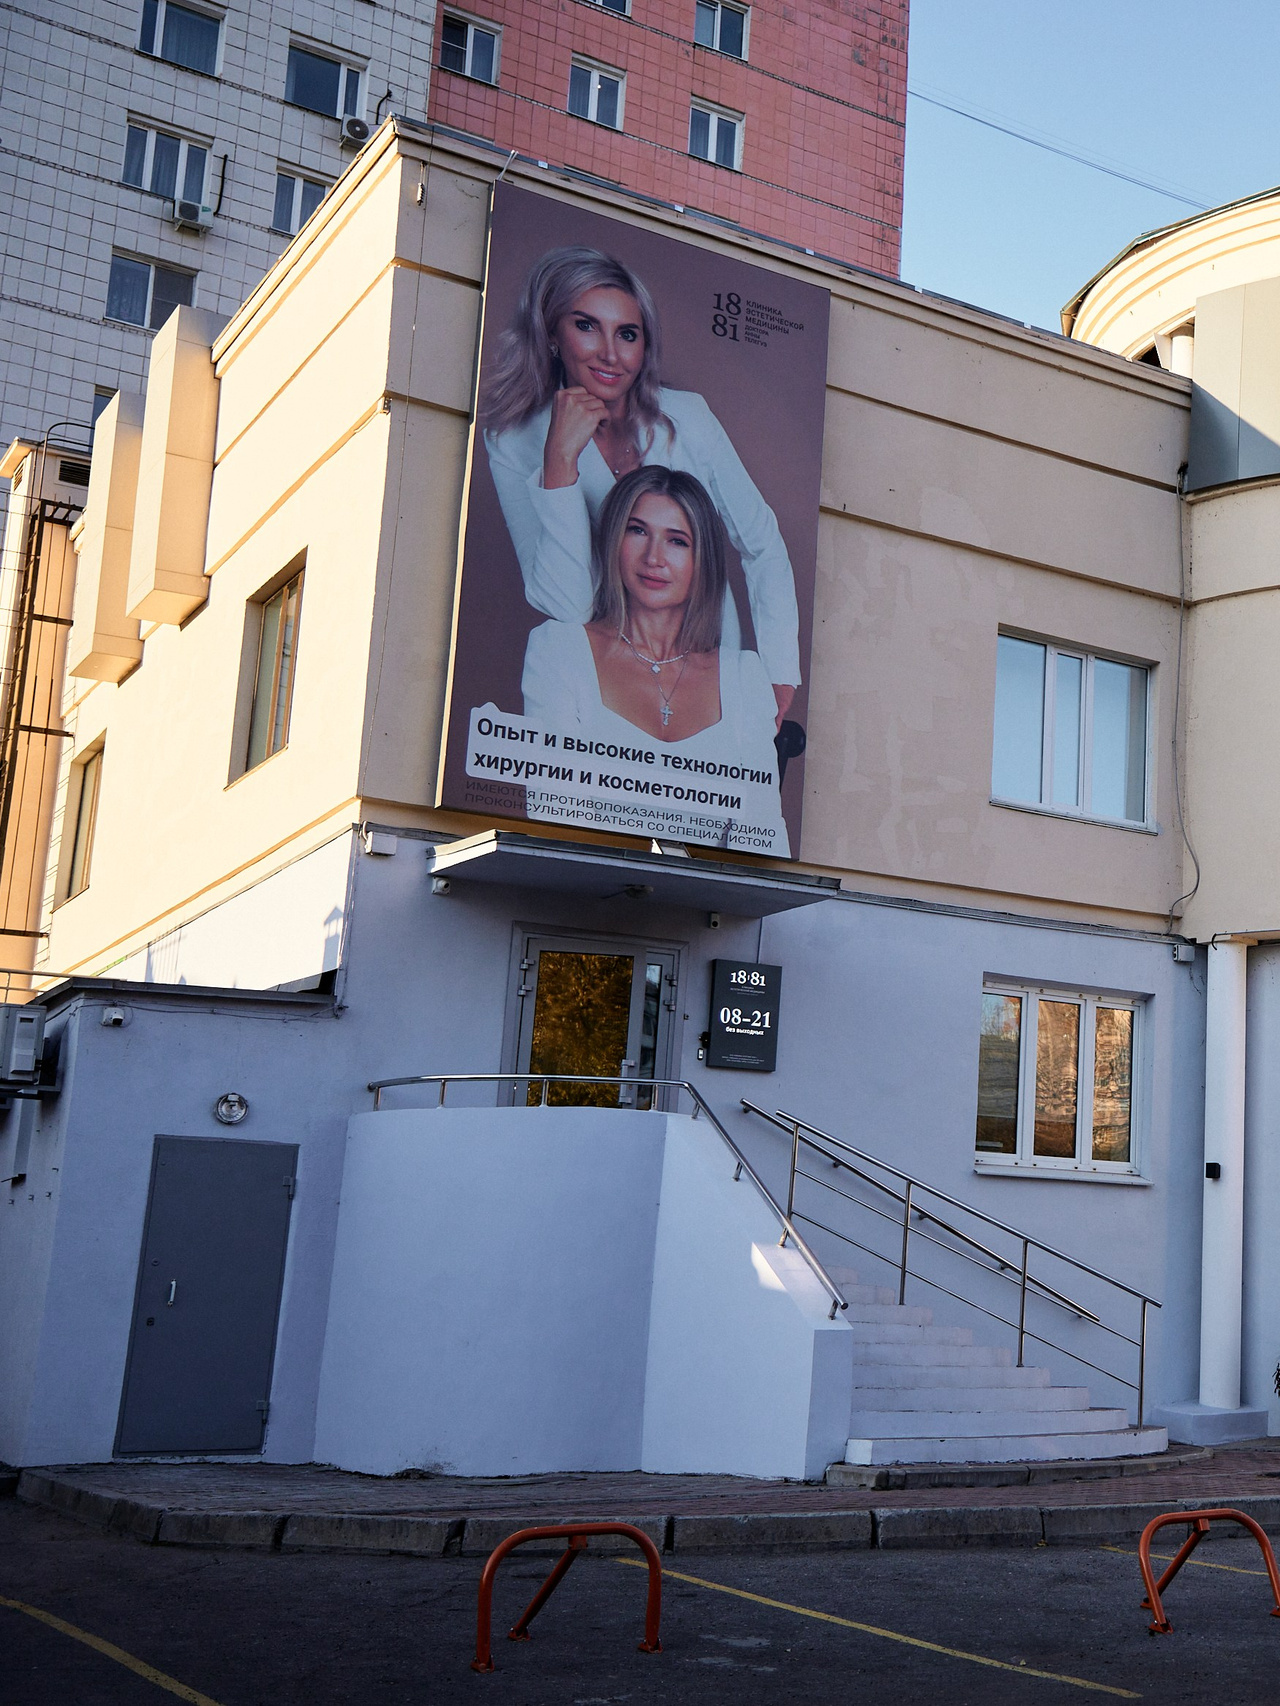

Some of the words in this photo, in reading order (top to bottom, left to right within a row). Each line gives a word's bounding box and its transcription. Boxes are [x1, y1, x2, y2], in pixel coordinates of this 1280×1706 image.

[713, 292, 742, 316] 18
[746, 300, 783, 317] КЛИНИКА
[712, 314, 740, 342] 81
[745, 308, 805, 331] ЭСТЕТИЧЕСКОЙ
[745, 316, 790, 335] МЕДИЦИНЫ
[477, 718, 539, 744] Опыт
[544, 733, 557, 748] и
[563, 736, 656, 765] высокие
[661, 753, 773, 785] технологии
[473, 752, 574, 781] хирургии
[579, 770, 592, 785] и
[598, 773, 742, 810] косметологии
[465, 793, 644, 829] ПРОКОНСУЛЬТИРОВАТЬСЯ
[647, 822, 665, 832] СО
[668, 824, 773, 849] СПЕЦИАЛИСТОМ
[466, 780, 536, 800] ИМЕЮТСЯ
[540, 792, 686, 824] ПРОТИВОПОКАЗАНИЯ.
[690, 816, 776, 838] НЕОБХОДИМО
[720, 1007, 771, 1028] 08-21
